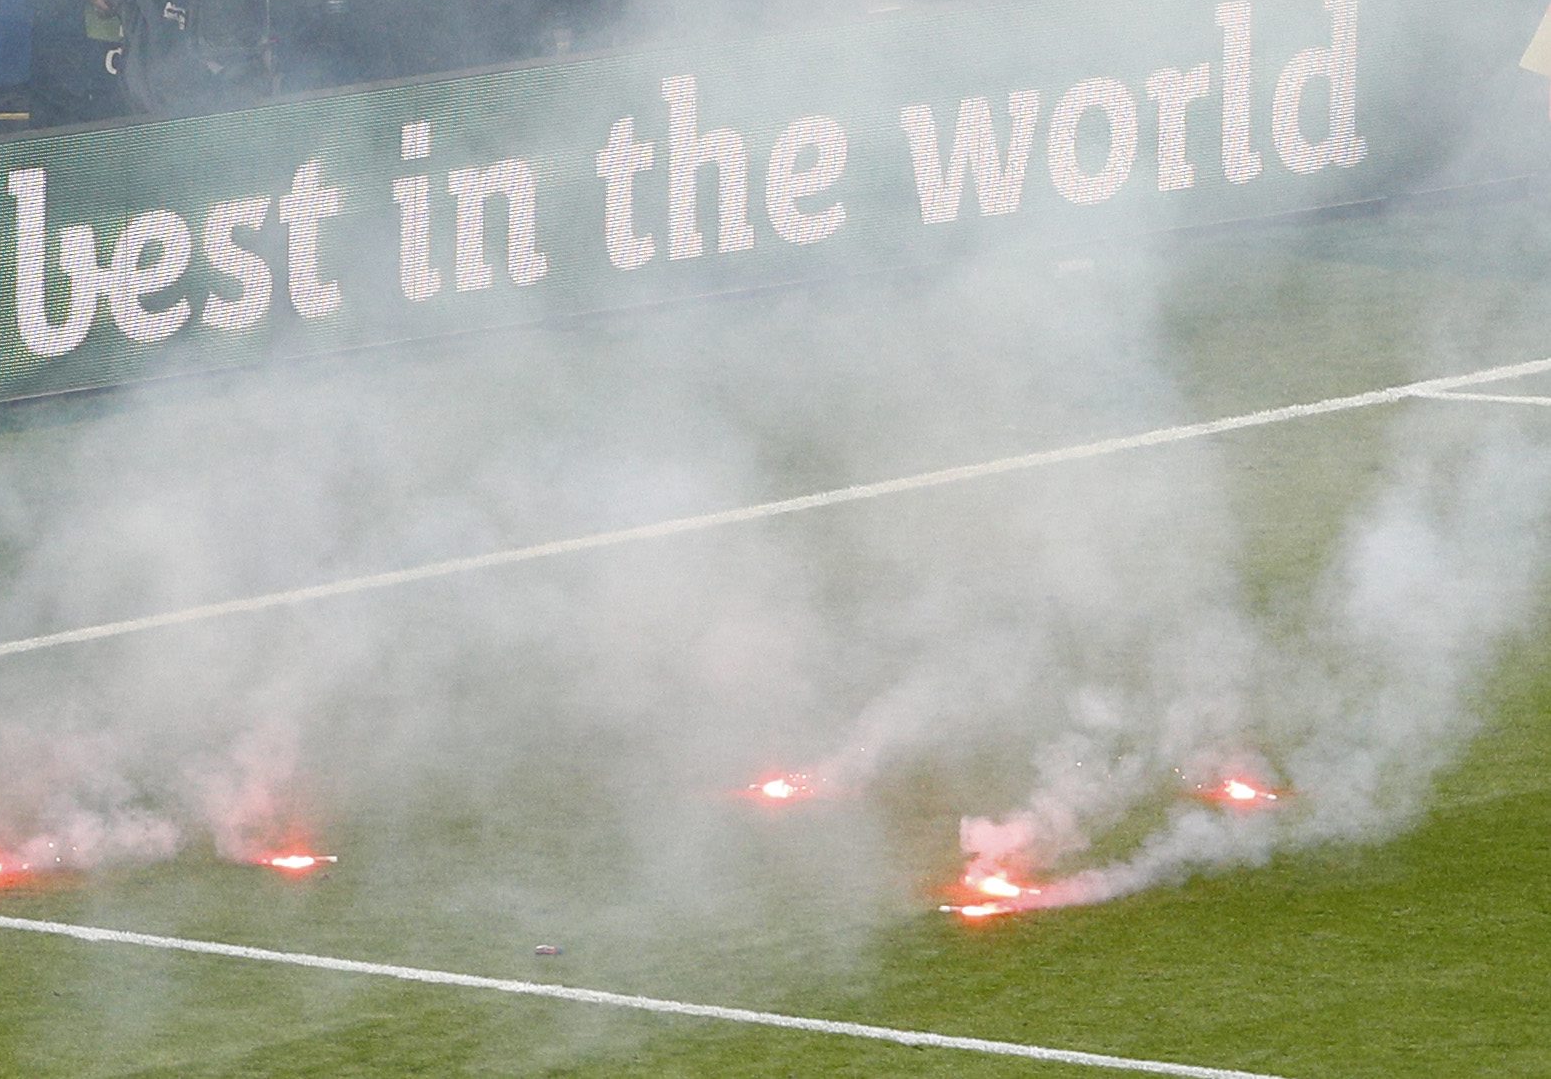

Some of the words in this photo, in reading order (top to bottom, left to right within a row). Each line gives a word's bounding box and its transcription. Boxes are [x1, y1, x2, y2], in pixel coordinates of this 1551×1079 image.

[6, 156, 349, 357] best
[392, 121, 549, 302] in
[595, 73, 850, 272] the
